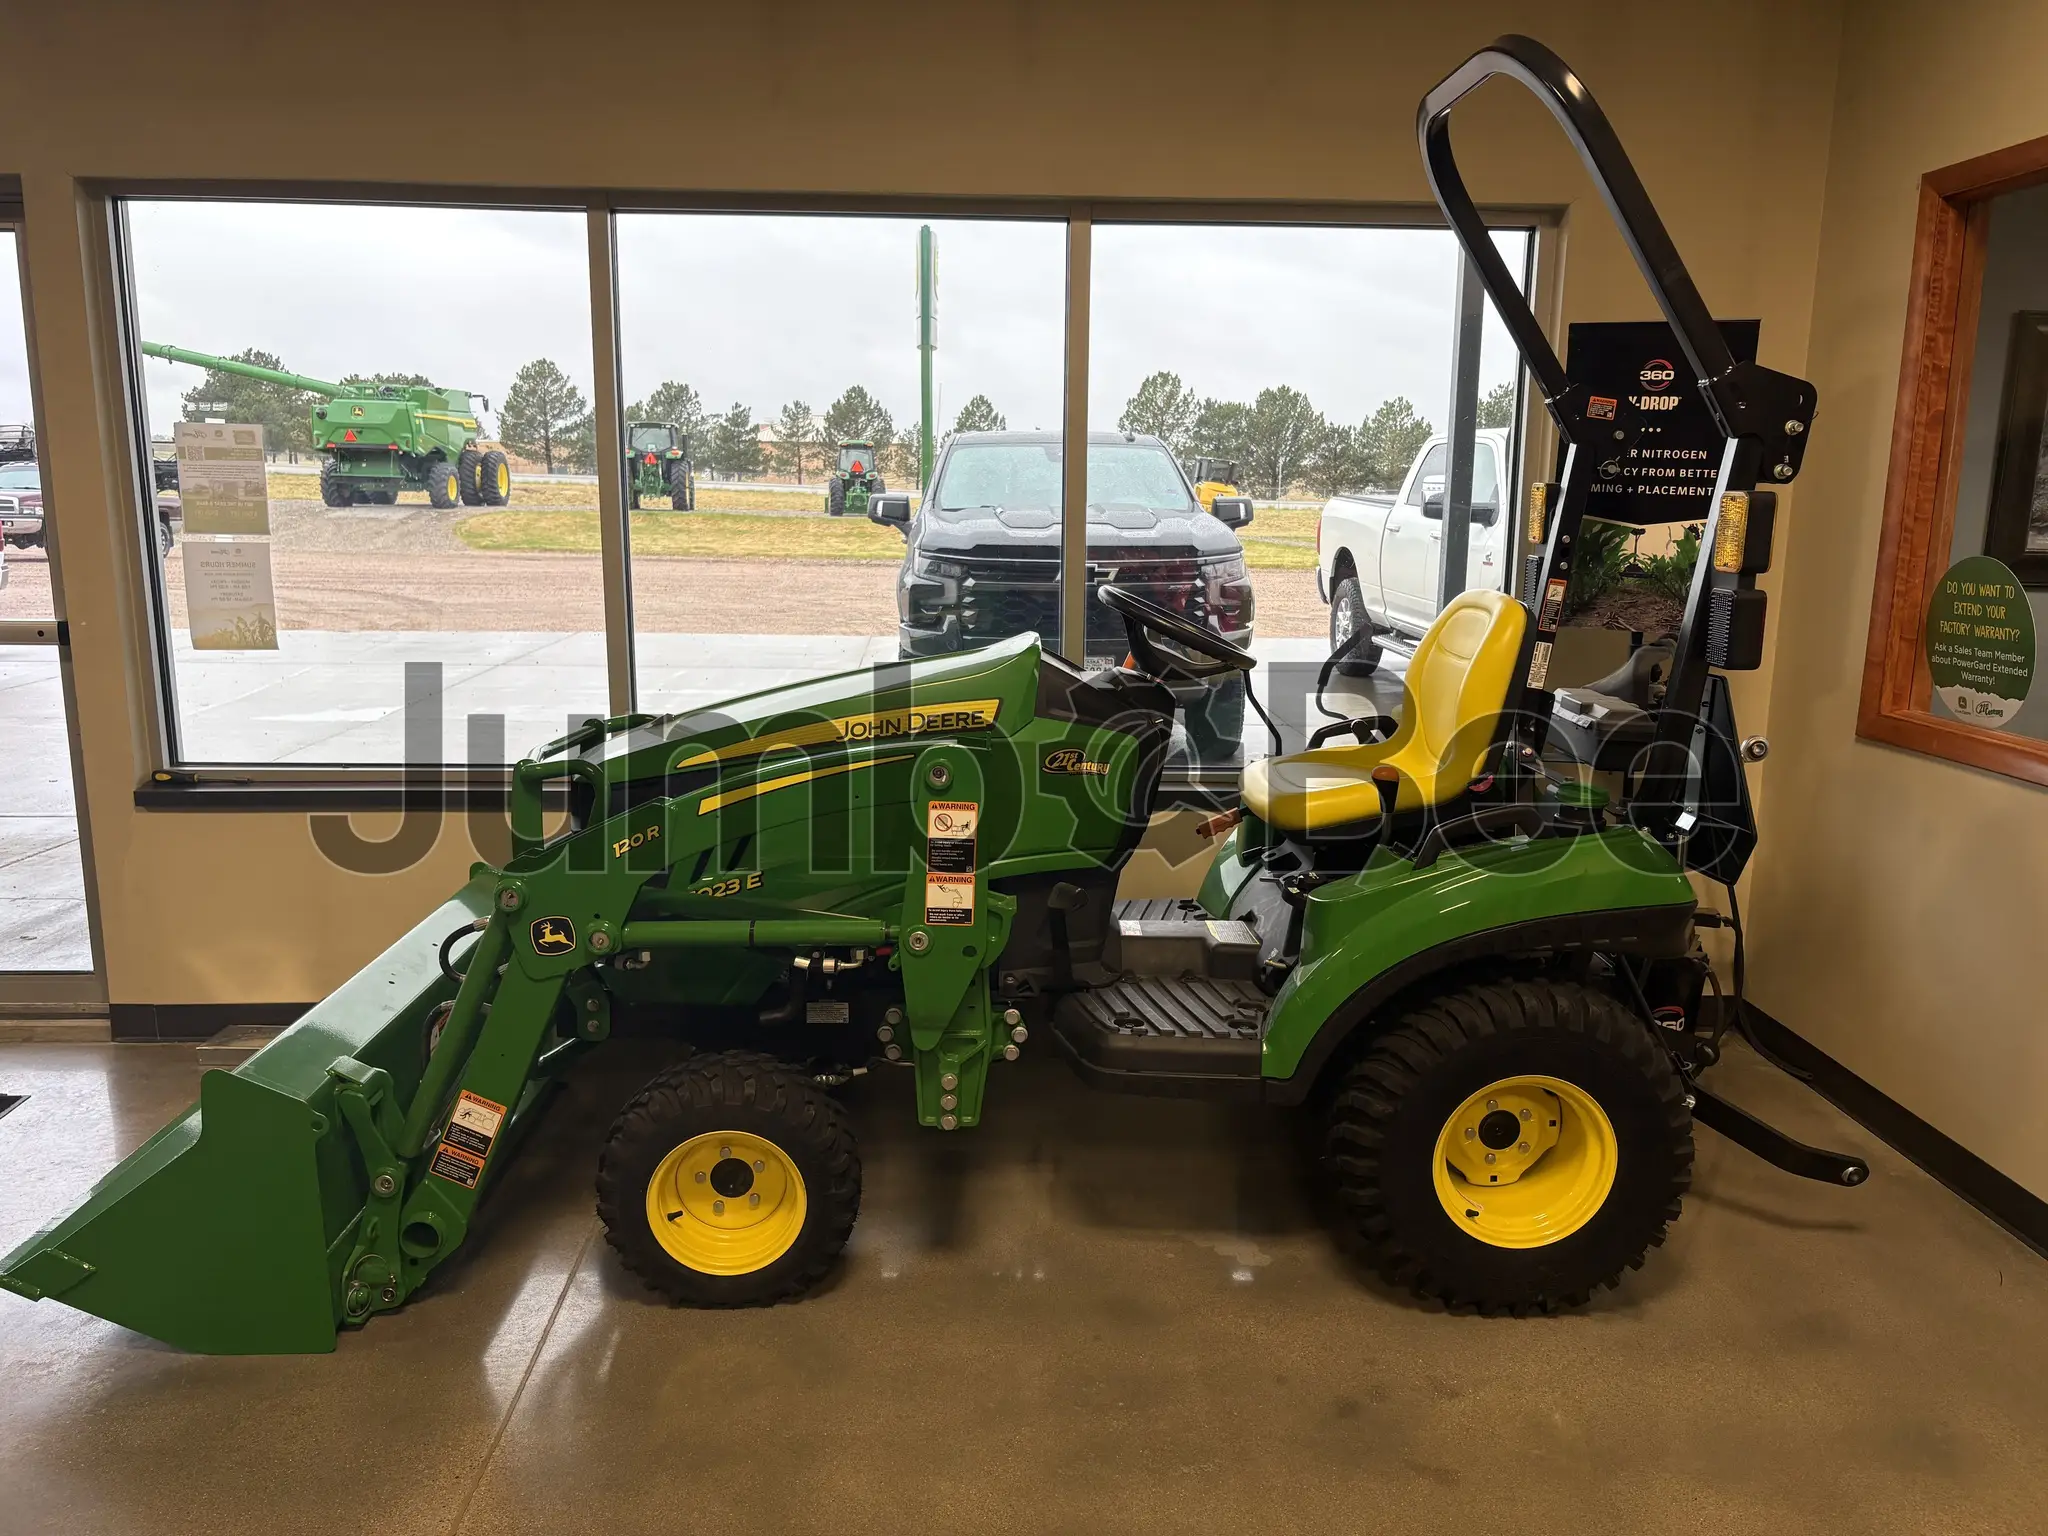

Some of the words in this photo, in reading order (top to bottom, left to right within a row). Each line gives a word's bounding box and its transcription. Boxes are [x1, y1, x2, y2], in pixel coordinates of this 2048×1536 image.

[1639, 370, 1675, 381] 360
[1641, 449, 1708, 460] NITROGEN
[1620, 467, 1639, 476] CY
[1641, 467, 1676, 477] FROM
[1679, 469, 1718, 479] BETTE
[1590, 483, 1623, 494] MING
[1637, 485, 1714, 496] PLACEMENT
[1946, 581, 1958, 594] DO
[1961, 582, 1976, 596] YOU
[1979, 584, 2001, 598] WANT
[2005, 585, 2015, 599] TO
[1953, 601, 1983, 616] EXTEND
[1986, 605, 2007, 620] YOUR
[1940, 620, 1970, 636] FACTORY
[1974, 625, 2021, 642] WARRANTY?
[1934, 642, 1947, 652] Ask
[1954, 645, 1973, 655] Sales
[1974, 648, 1993, 659] Team
[1994, 651, 2025, 663] Member
[1931, 654, 1951, 665] about
[1952, 658, 1991, 672] PowerGard
[1993, 665, 2029, 677] Extended
[1961, 670, 1996, 685] Warranty!
[836, 718, 900, 740] JOHN
[908, 711, 985, 732] DEERE
[938, 803, 976, 811] WARNING
[612, 833, 645, 858] 120
[646, 825, 661, 841] R
[746, 871, 763, 890] E
[936, 876, 973, 884] WARNING
[472, 1096, 501, 1112] WARNING
[451, 1150, 479, 1166] WARNING
